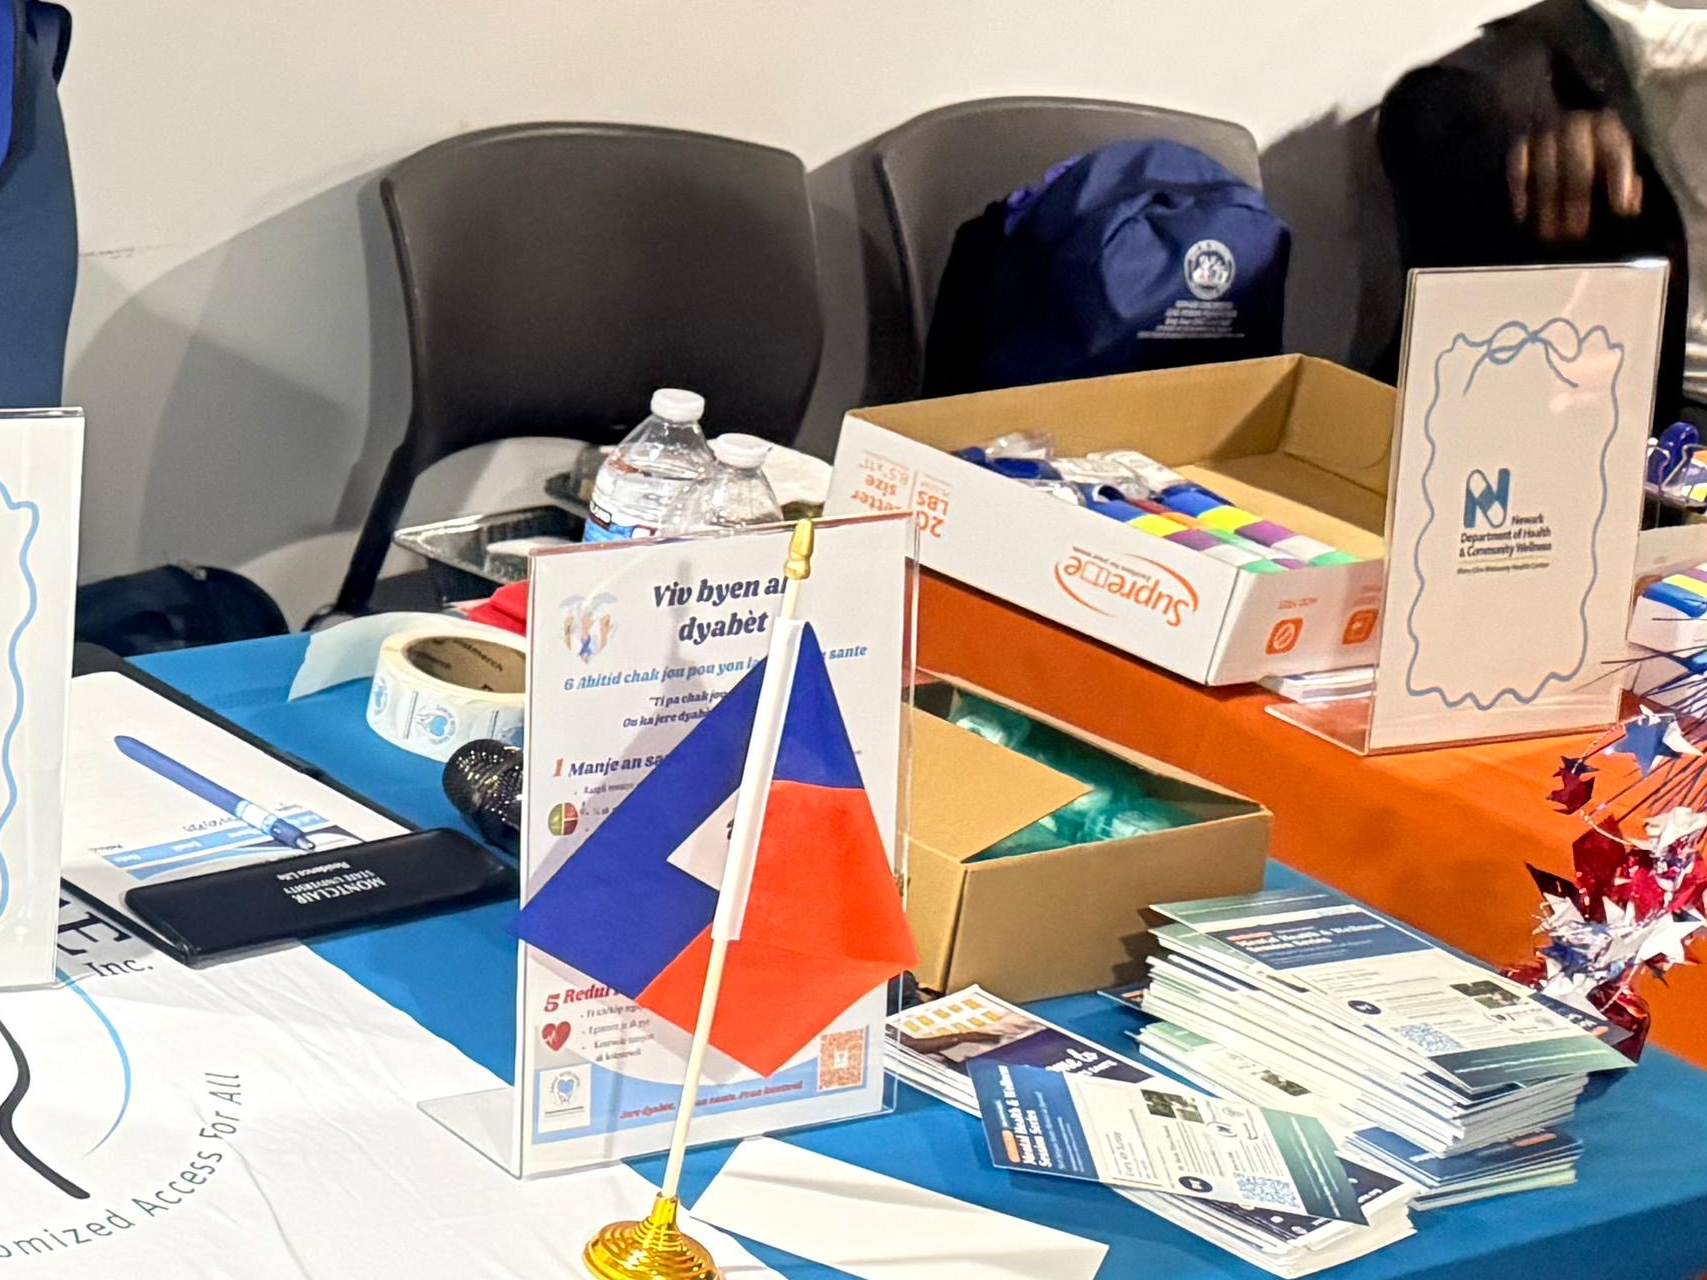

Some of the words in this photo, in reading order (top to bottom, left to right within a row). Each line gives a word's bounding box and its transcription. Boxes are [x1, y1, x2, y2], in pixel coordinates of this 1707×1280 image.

[864, 474, 897, 497] size
[850, 489, 902, 511] etter
[916, 491, 950, 516] LBS
[1460, 531, 1512, 544] Department
[1523, 527, 1552, 539] Health
[1467, 544, 1515, 557] Community
[654, 581, 692, 607] Viv
[696, 578, 759, 604] byen
[678, 610, 767, 642] dyabèt
[828, 645, 867, 659] sante
[569, 757, 619, 776] Manje
[619, 756, 642, 770] an
[283, 876, 345, 894] UNIVERSITY
[342, 869, 375, 882] STATE
[291, 876, 386, 905] MONTCLAIR
[85, 954, 153, 979] Inc.
[543, 992, 560, 1012] 5
[204, 1072, 243, 1106] All
[198, 1110, 241, 1140] For
[131, 1149, 224, 1218] Access
